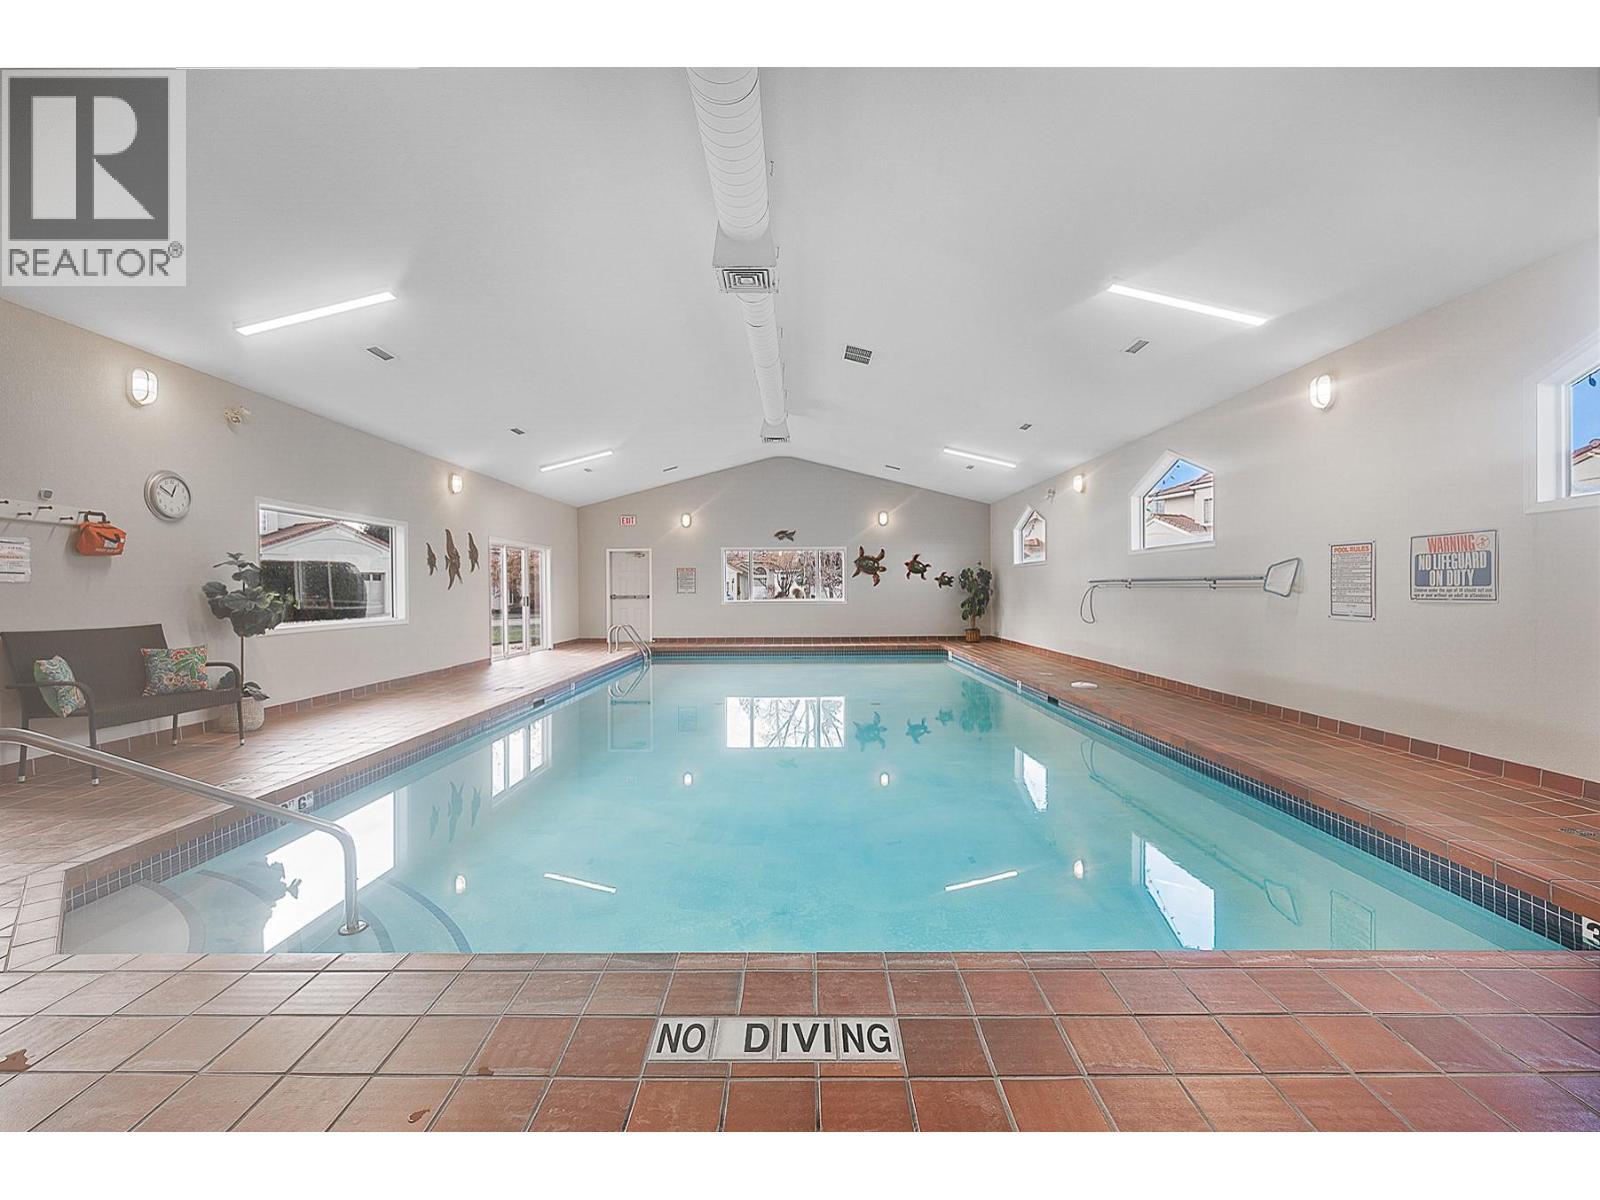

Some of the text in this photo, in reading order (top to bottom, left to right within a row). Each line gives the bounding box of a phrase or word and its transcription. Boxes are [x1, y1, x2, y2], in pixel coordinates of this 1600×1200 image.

[621, 516, 634, 525] EXIT
[1349, 545, 1370, 553] RULES
[1427, 534, 1475, 553] WARNING
[1418, 551, 1487, 571] NO LIFEGUARD
[1429, 568, 1475, 587] ON DUTY
[656, 1023, 892, 1053] NO DIVING
